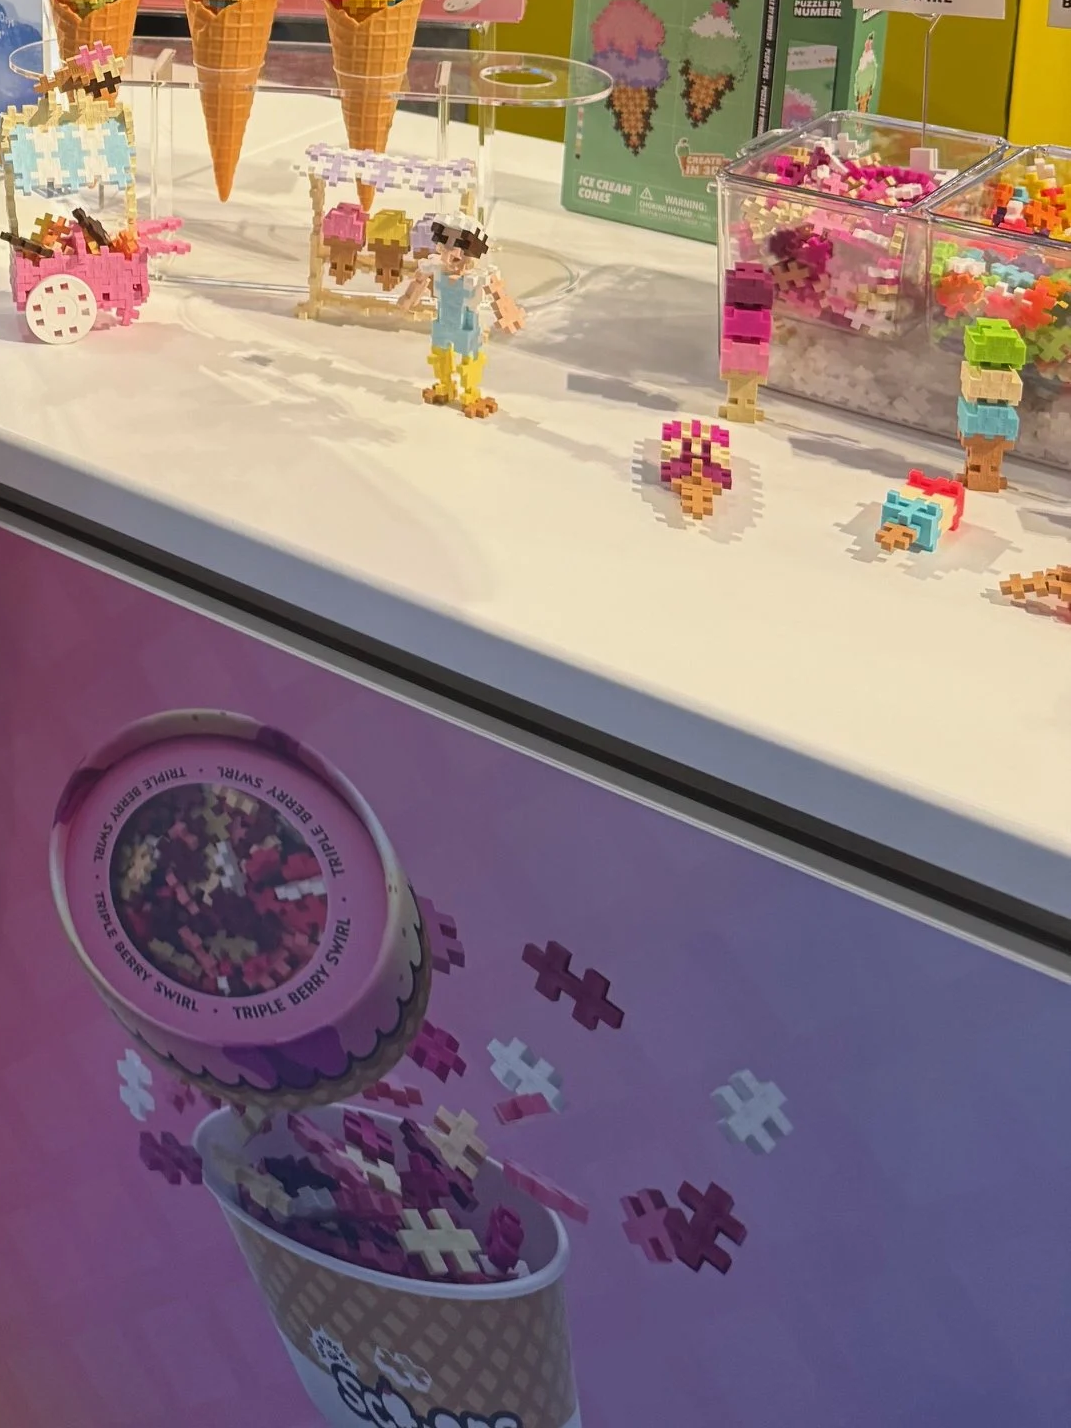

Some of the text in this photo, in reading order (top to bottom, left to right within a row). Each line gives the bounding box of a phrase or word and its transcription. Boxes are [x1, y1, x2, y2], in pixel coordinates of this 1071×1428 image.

[794, 0, 842, 8] PUZZLE BY
[794, 7, 842, 18] NUMBER
[578, 174, 632, 196] ICE CREAM
[578, 187, 612, 205] CONES
[93, 766, 188, 864] TRIPLE BERRY SWIRL
[216, 765, 346, 879] TRIPLE BERRY SWIRL
[94, 890, 199, 1013] TRIPLE BERRY SWIRL
[232, 917, 351, 1021] TRIPLE BERRY SWIRL
